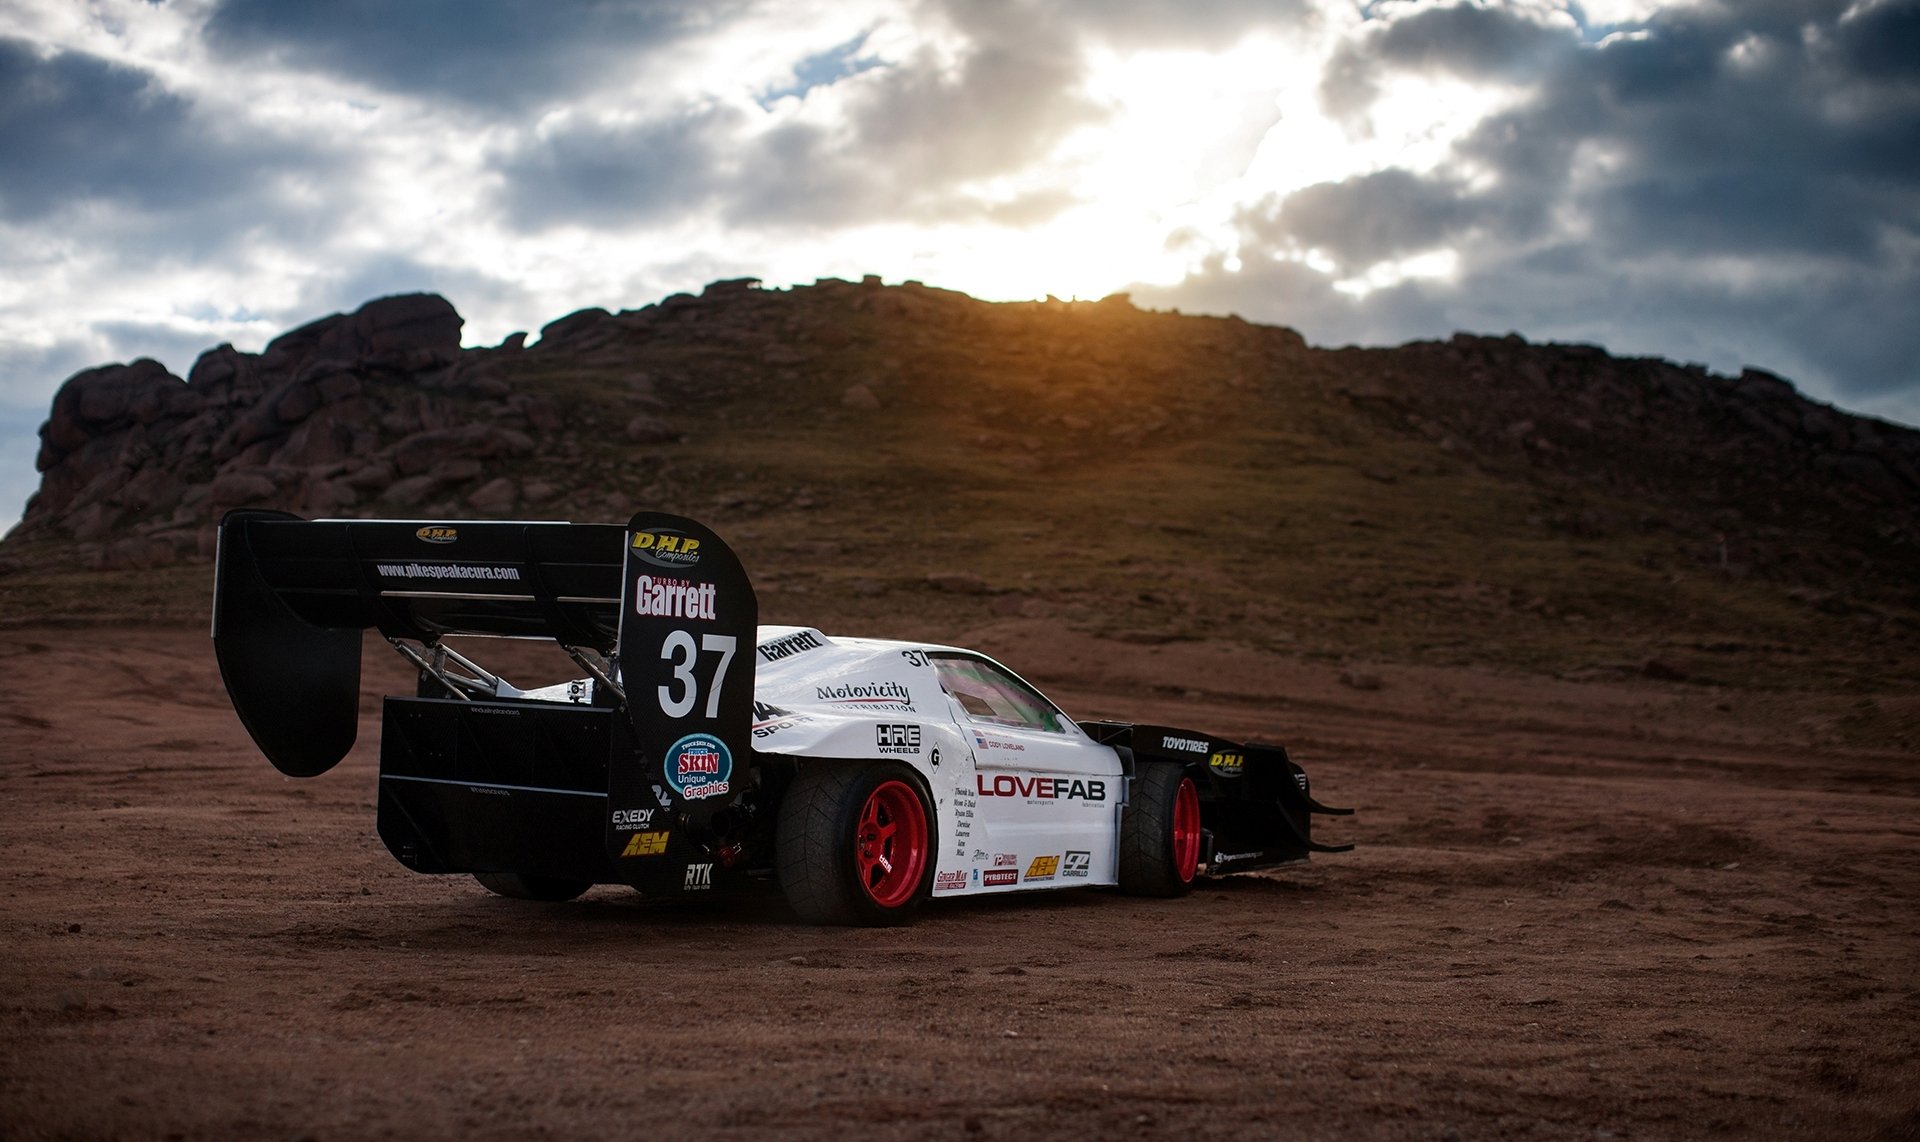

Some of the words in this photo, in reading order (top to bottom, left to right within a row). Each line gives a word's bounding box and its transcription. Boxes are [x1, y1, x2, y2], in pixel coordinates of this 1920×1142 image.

[632, 532, 700, 555] D.H.P.
[655, 548, 701, 563] Composites
[377, 563, 520, 580] www.pikespeakacura.com
[652, 577, 678, 586] TURBO
[636, 575, 717, 621] Garrett
[757, 631, 823, 662] Garrett
[902, 649, 929, 667] 37
[658, 630, 737, 718] 37
[816, 682, 910, 705] Motovicity
[877, 724, 920, 746] HRE
[1162, 736, 1186, 751] TOYO
[1185, 738, 1210, 754] TIRES
[678, 753, 720, 774] SKIN
[931, 748, 940, 766] G
[678, 774, 706, 784] Unique
[977, 775, 1106, 801] LOVEFAB
[684, 782, 730, 799] Graphics
[612, 809, 655, 824] EXEDY
[620, 831, 670, 857] AEM
[685, 863, 713, 885] RTK
[985, 872, 1017, 881] PYROTECT
[1063, 870, 1088, 878] CARRILLO
